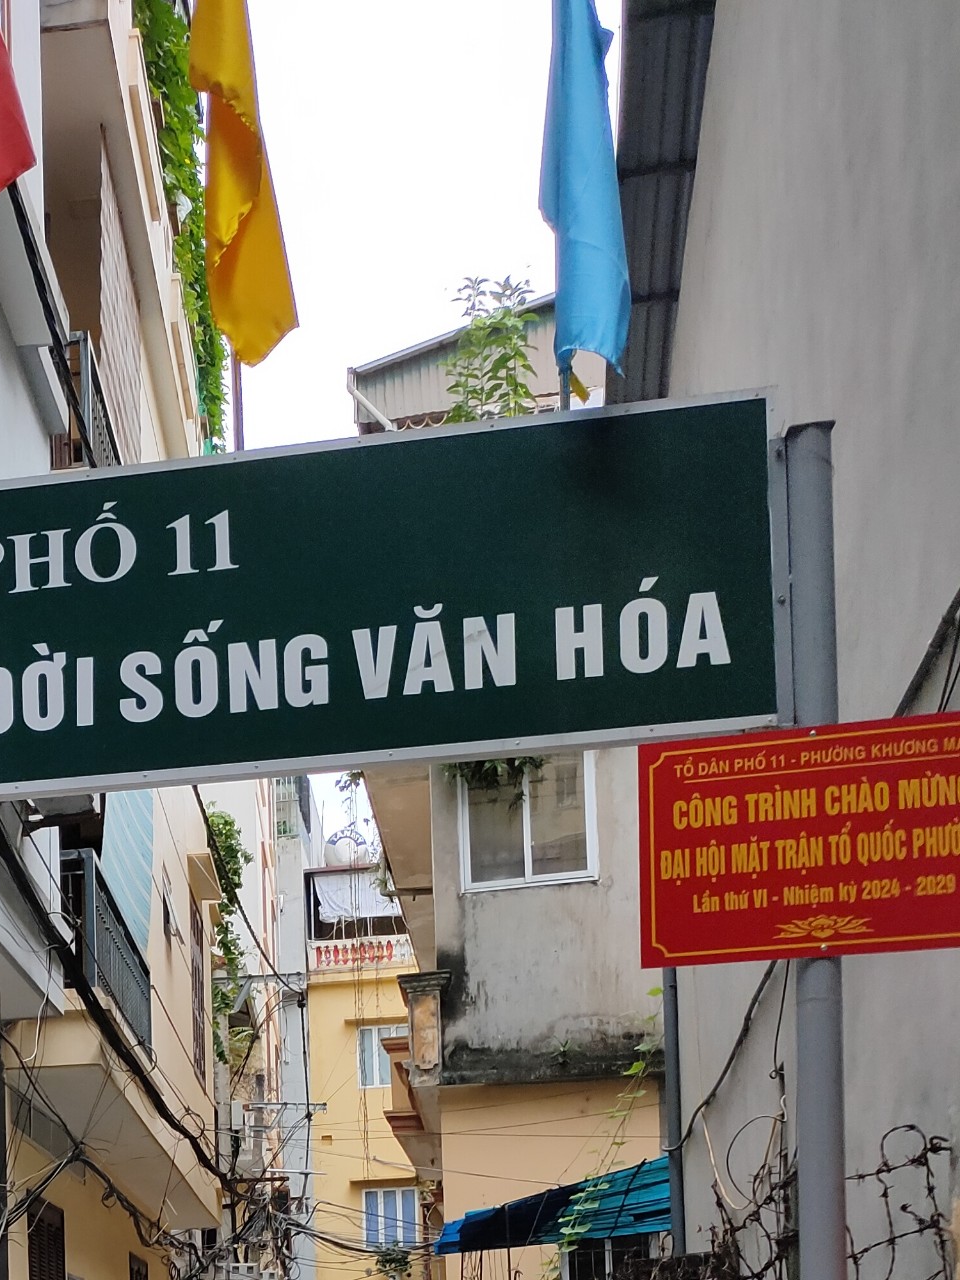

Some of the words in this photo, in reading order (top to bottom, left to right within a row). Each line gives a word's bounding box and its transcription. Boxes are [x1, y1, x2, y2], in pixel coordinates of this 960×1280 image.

[165, 509, 240, 576] 11
[119, 619, 329, 723] SỐNG
[351, 603, 517, 700] VĂN
[554, 576, 732, 681] HÓA
[674, 757, 694, 777] TỔ
[699, 758, 730, 776] DÂN
[734, 750, 766, 772] PHỐ
[770, 754, 786, 769] 11
[800, 745, 867, 766] PHƯỜNG
[871, 738, 939, 758] KHƯƠNG
[673, 793, 738, 830] CÔNG
[744, 784, 817, 823] TRÌNH
[824, 776, 890, 816] CHÀO
[898, 770, 960, 810] MỪN
[660, 850, 690, 886] ĐẠI
[695, 840, 726, 883] HỘI
[731, 836, 770, 879] MẶT
[776, 831, 824, 876] TRẬN
[829, 821, 852, 866] TỔ
[856, 818, 907, 867] QUỐC
[693, 891, 721, 914] Lần
[724, 885, 750, 911] thứ
[753, 888, 768, 909] VI
[783, 885, 835, 908] Nhiệm
[838, 880, 858, 905] kỳ
[861, 878, 901, 900] 2024
[916, 874, 956, 896] 2029
